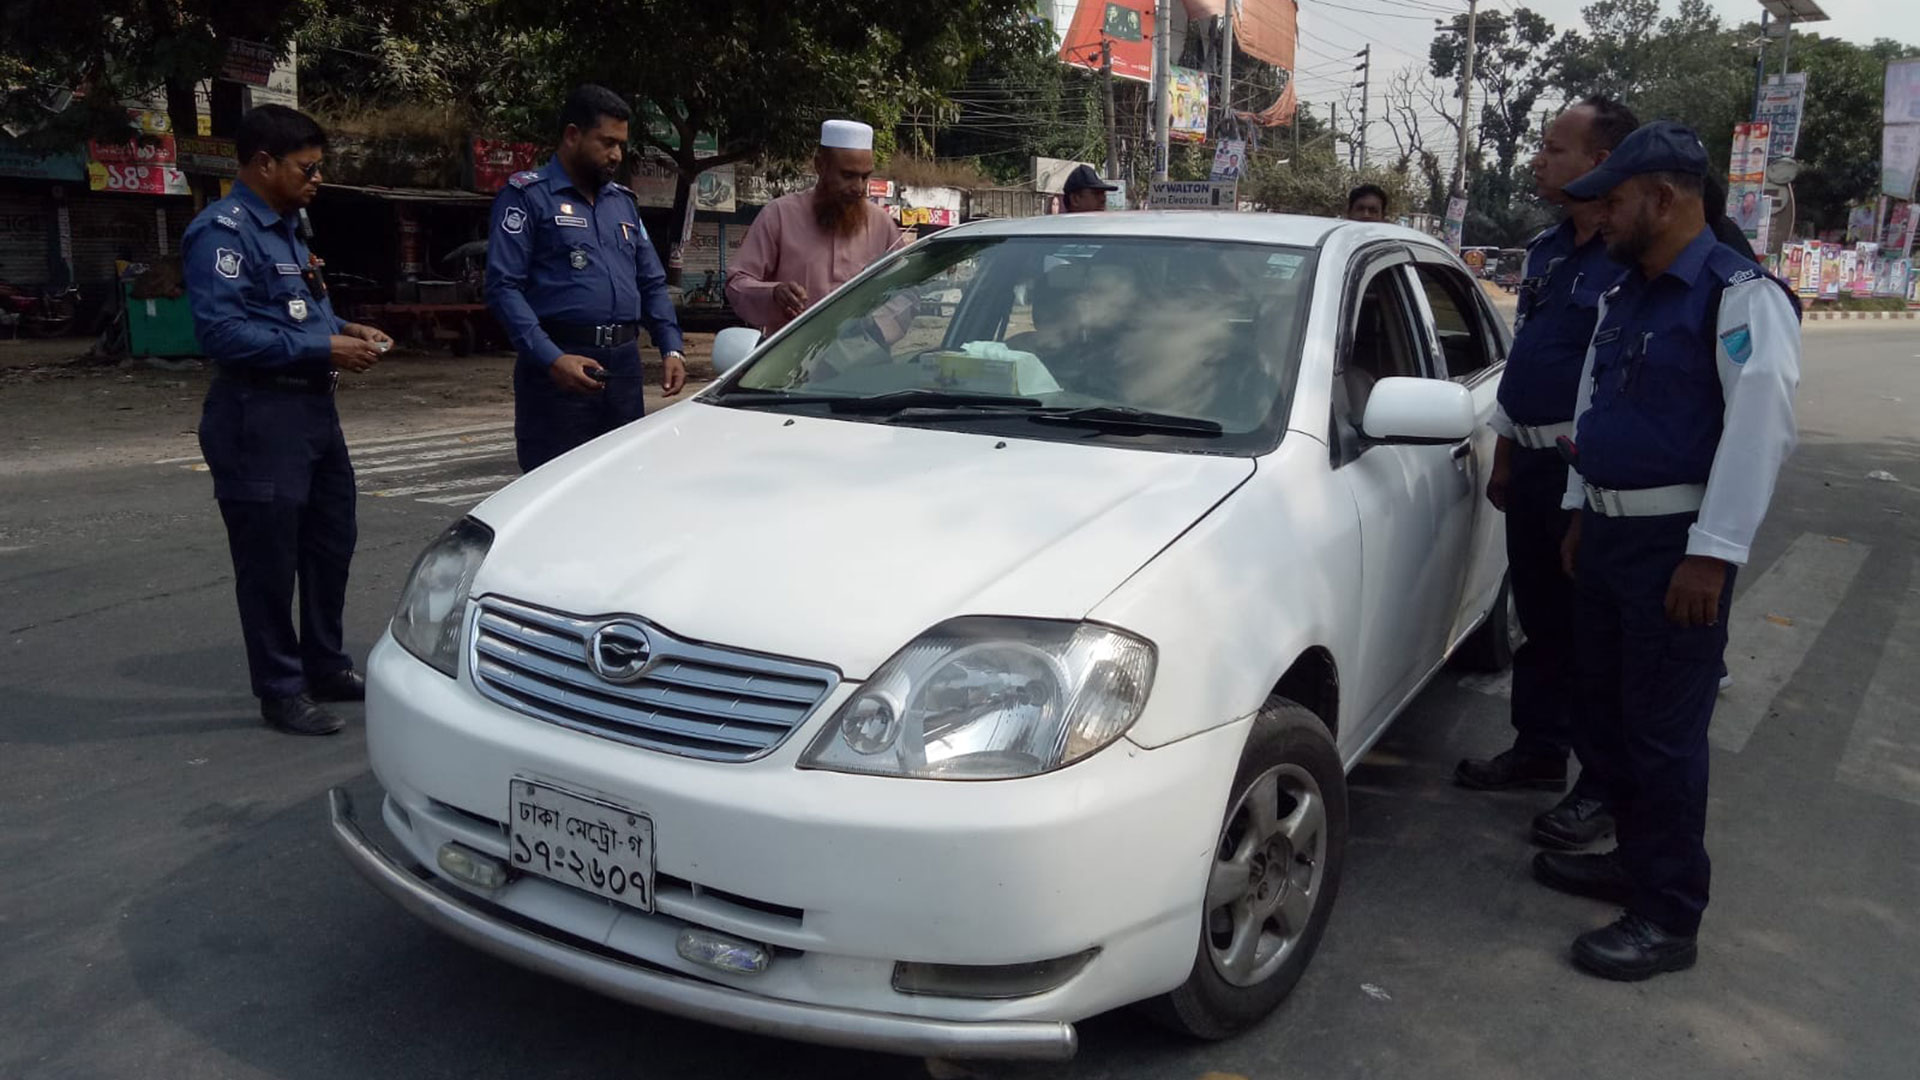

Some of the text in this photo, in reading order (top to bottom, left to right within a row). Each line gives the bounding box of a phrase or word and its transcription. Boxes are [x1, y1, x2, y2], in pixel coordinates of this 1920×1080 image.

[1167, 184, 1209, 193] WALTON
[519, 802, 560, 831] ঢাকা
[514, 833, 647, 905] ১৭-২৬০৭
